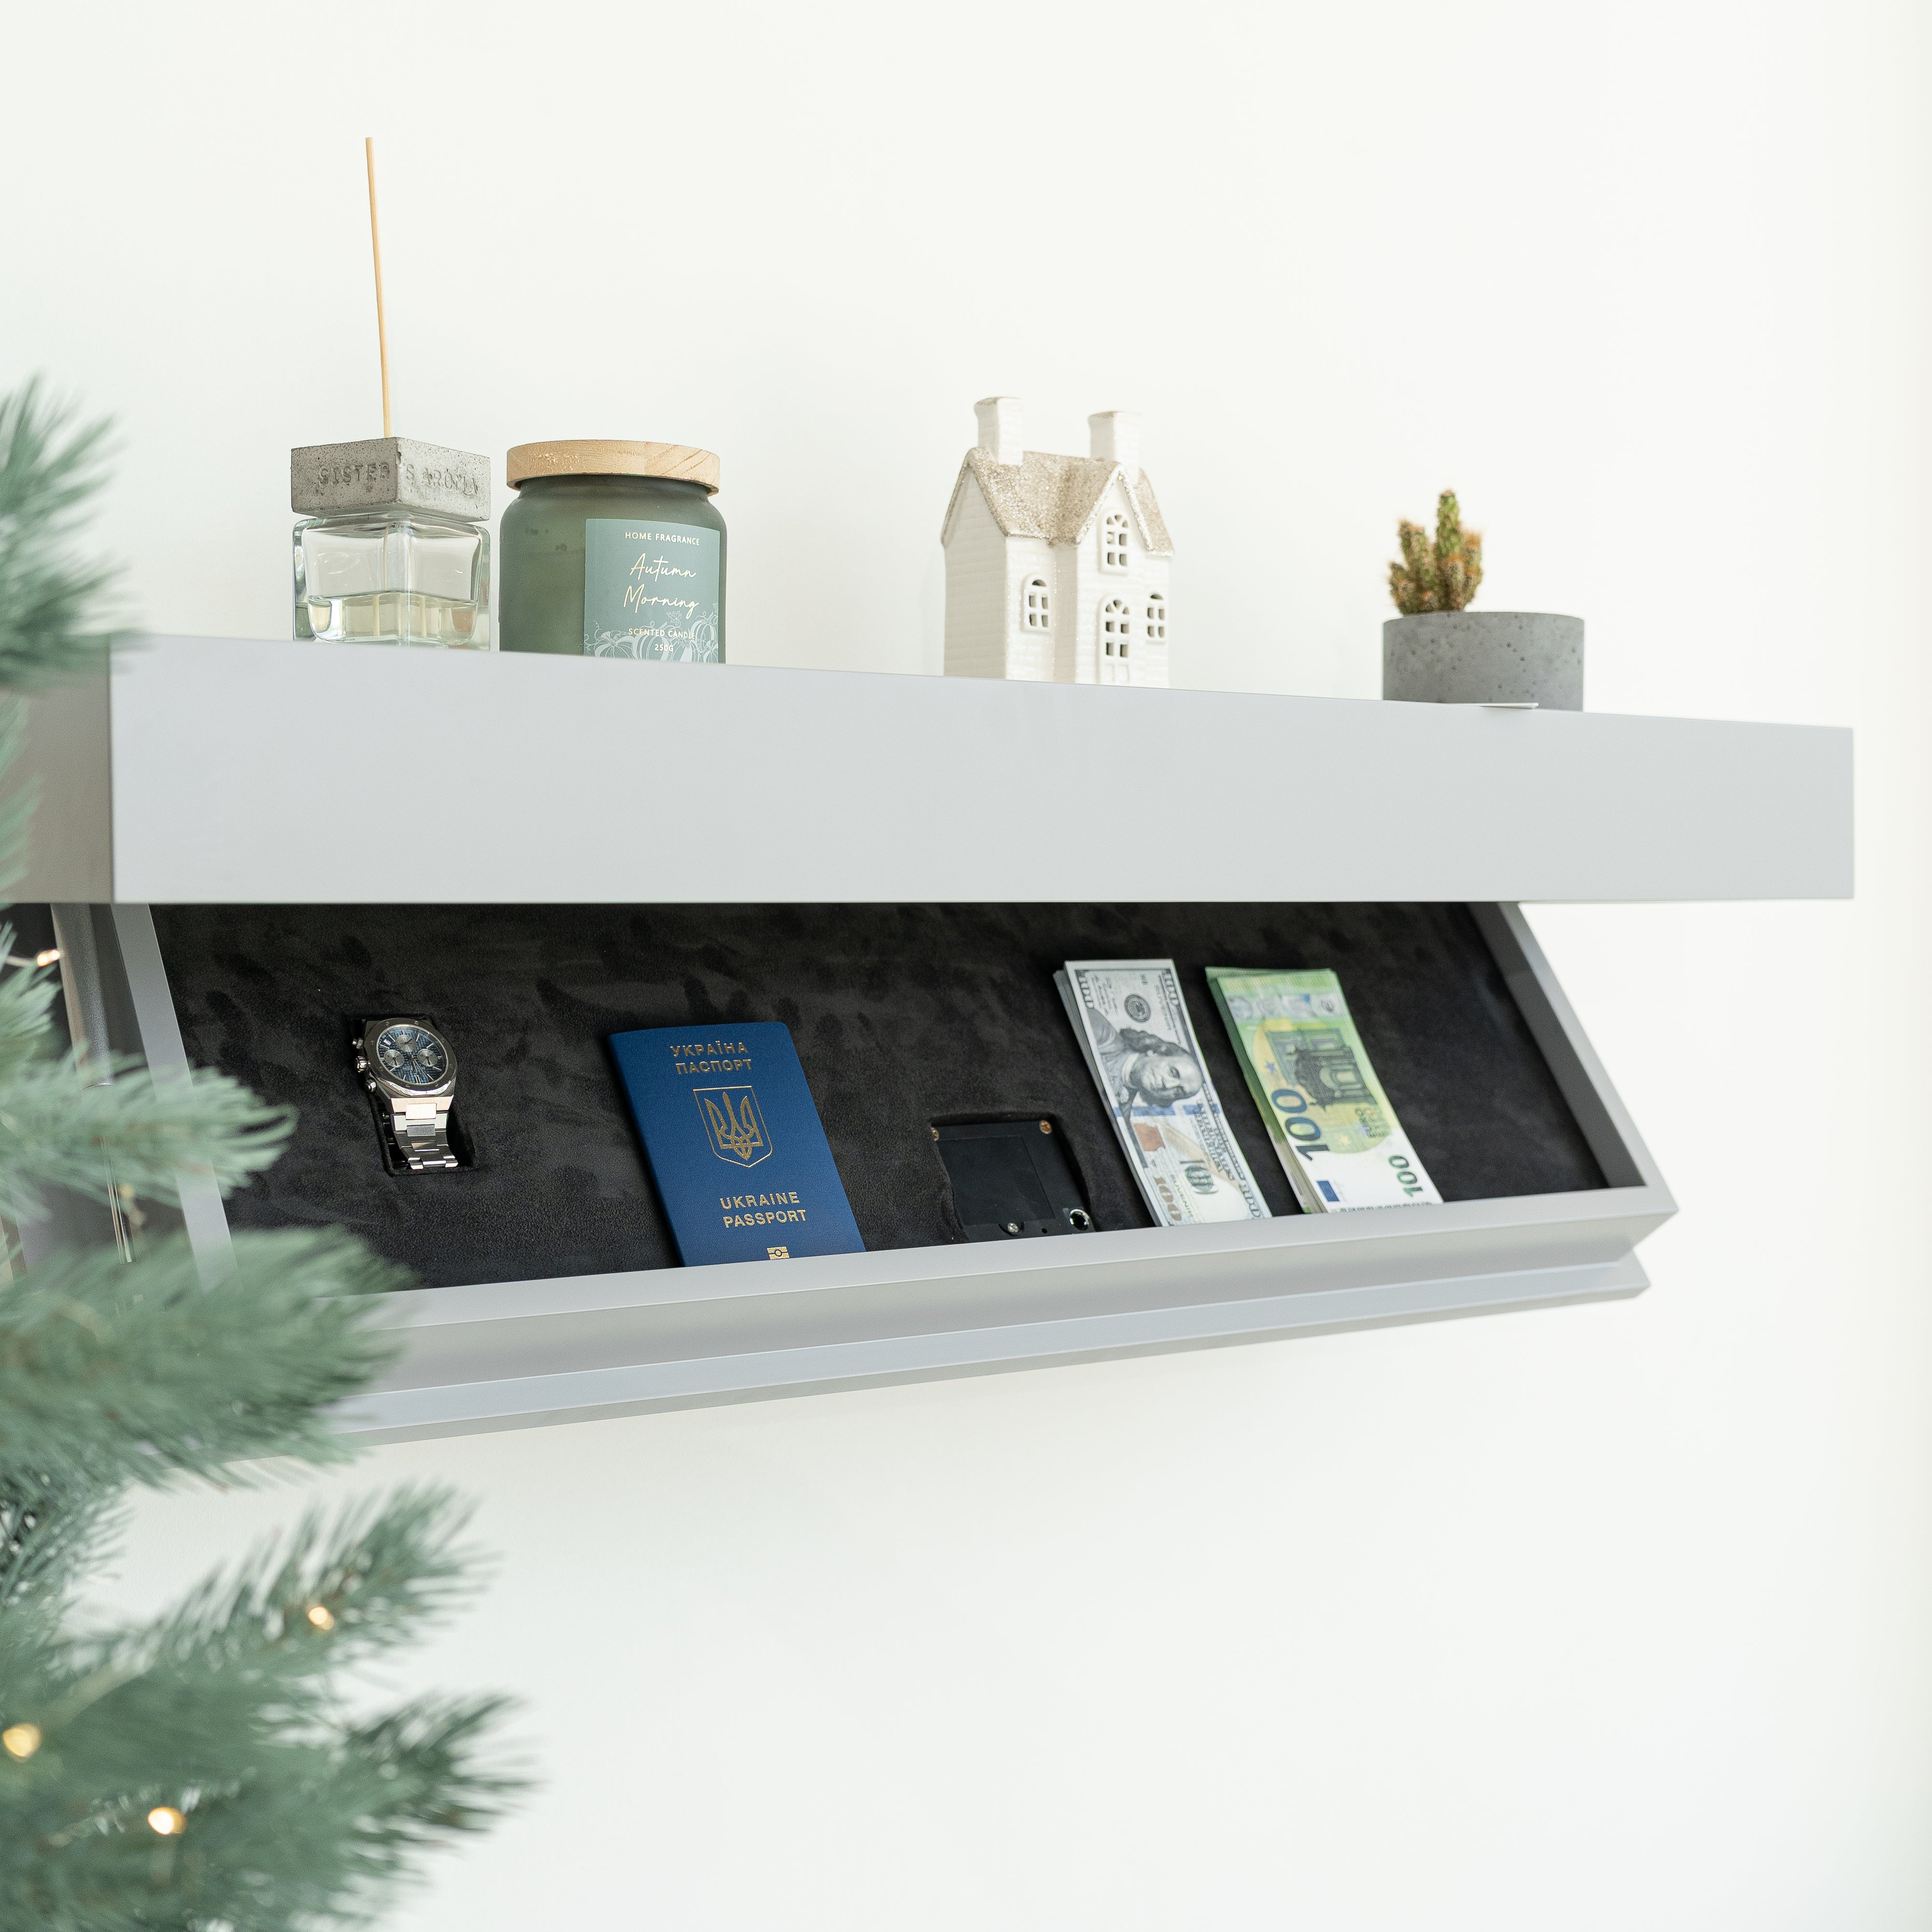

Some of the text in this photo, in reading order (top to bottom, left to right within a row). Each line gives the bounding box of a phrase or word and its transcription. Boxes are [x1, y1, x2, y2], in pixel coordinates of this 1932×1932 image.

[625, 532, 700, 546] HOME FRAGRANCE
[629, 553, 696, 582] Autumn
[623, 583, 699, 620] Morning
[628, 628, 695, 640] SCENTED CANDLE
[654, 643, 674, 652] 250G
[669, 1040, 749, 1058] УКРАЇНА
[676, 1059, 752, 1075] ПАСПОРТ
[1271, 1089, 1330, 1161] 100
[1388, 1155, 1424, 1197] 100
[720, 1192, 800, 1209] UKRAINE
[1153, 1176, 1182, 1222] 100
[723, 1209, 806, 1228] PASSPORT
